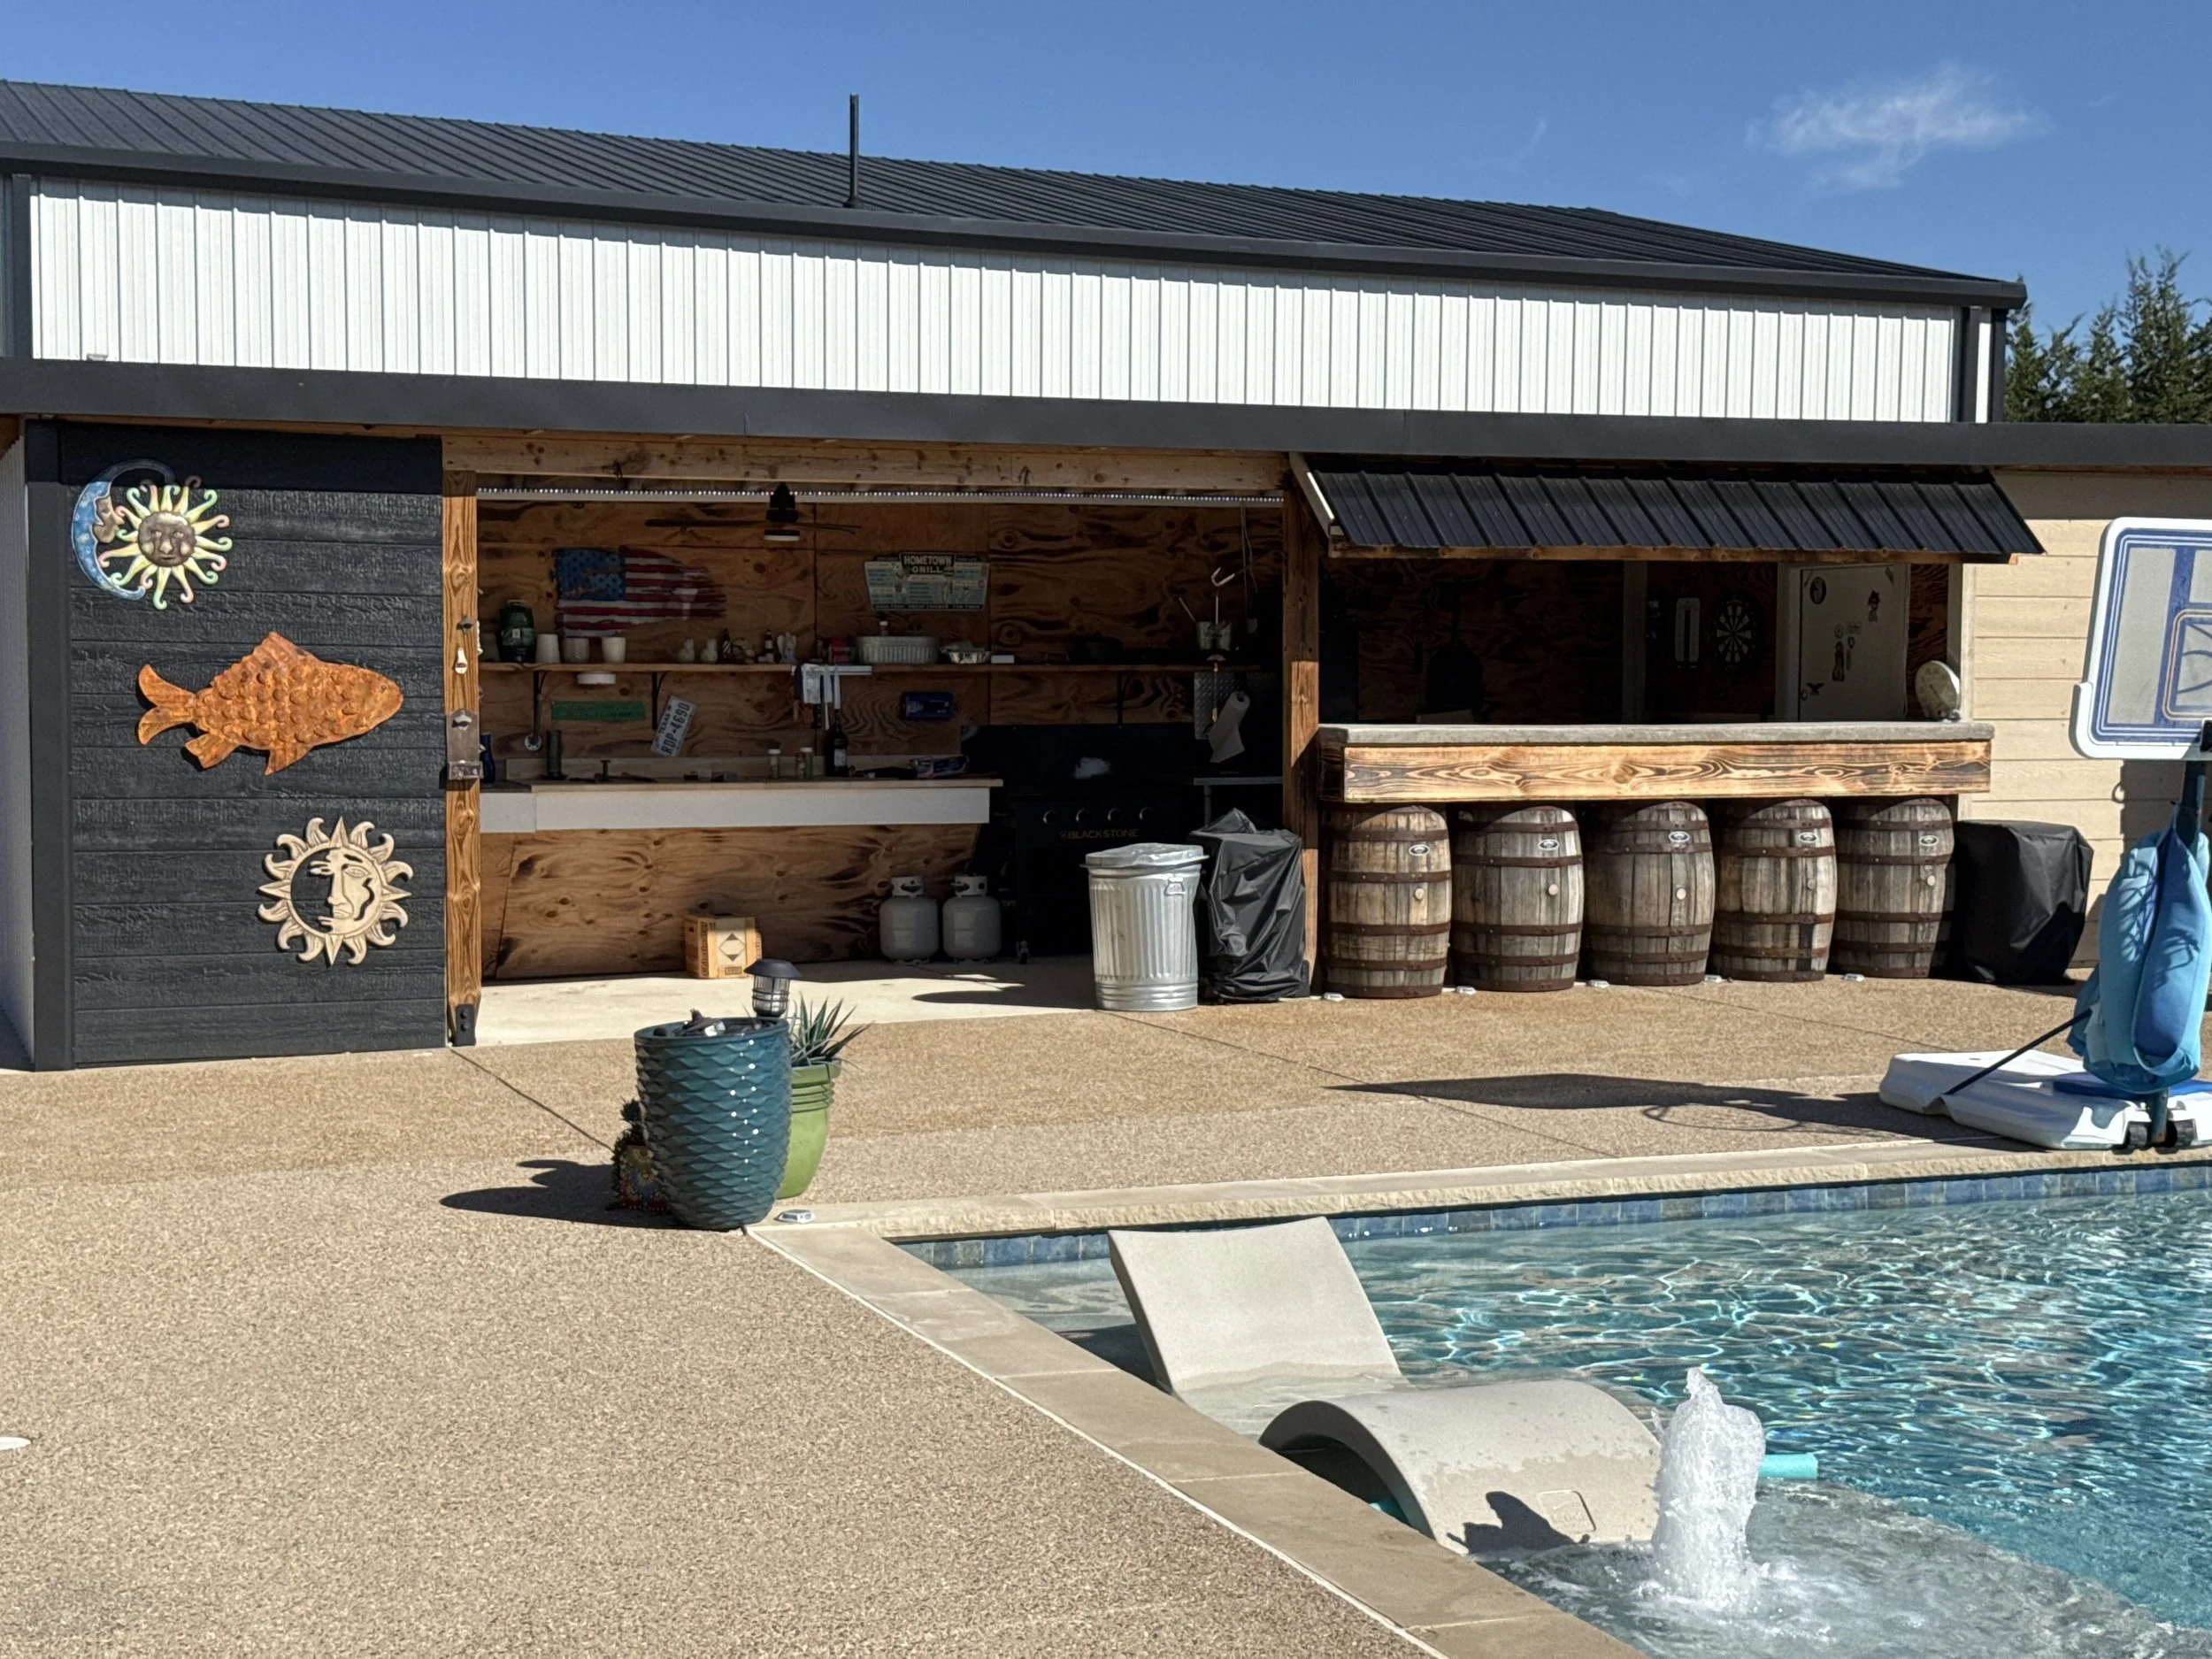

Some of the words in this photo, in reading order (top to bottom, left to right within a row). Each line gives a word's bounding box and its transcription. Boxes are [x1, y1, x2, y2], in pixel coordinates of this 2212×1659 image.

[903, 555, 952, 565] HOMETOWN
[658, 714, 671, 733] TEXAS
[1068, 829, 1139, 840] BLACKSTONE
